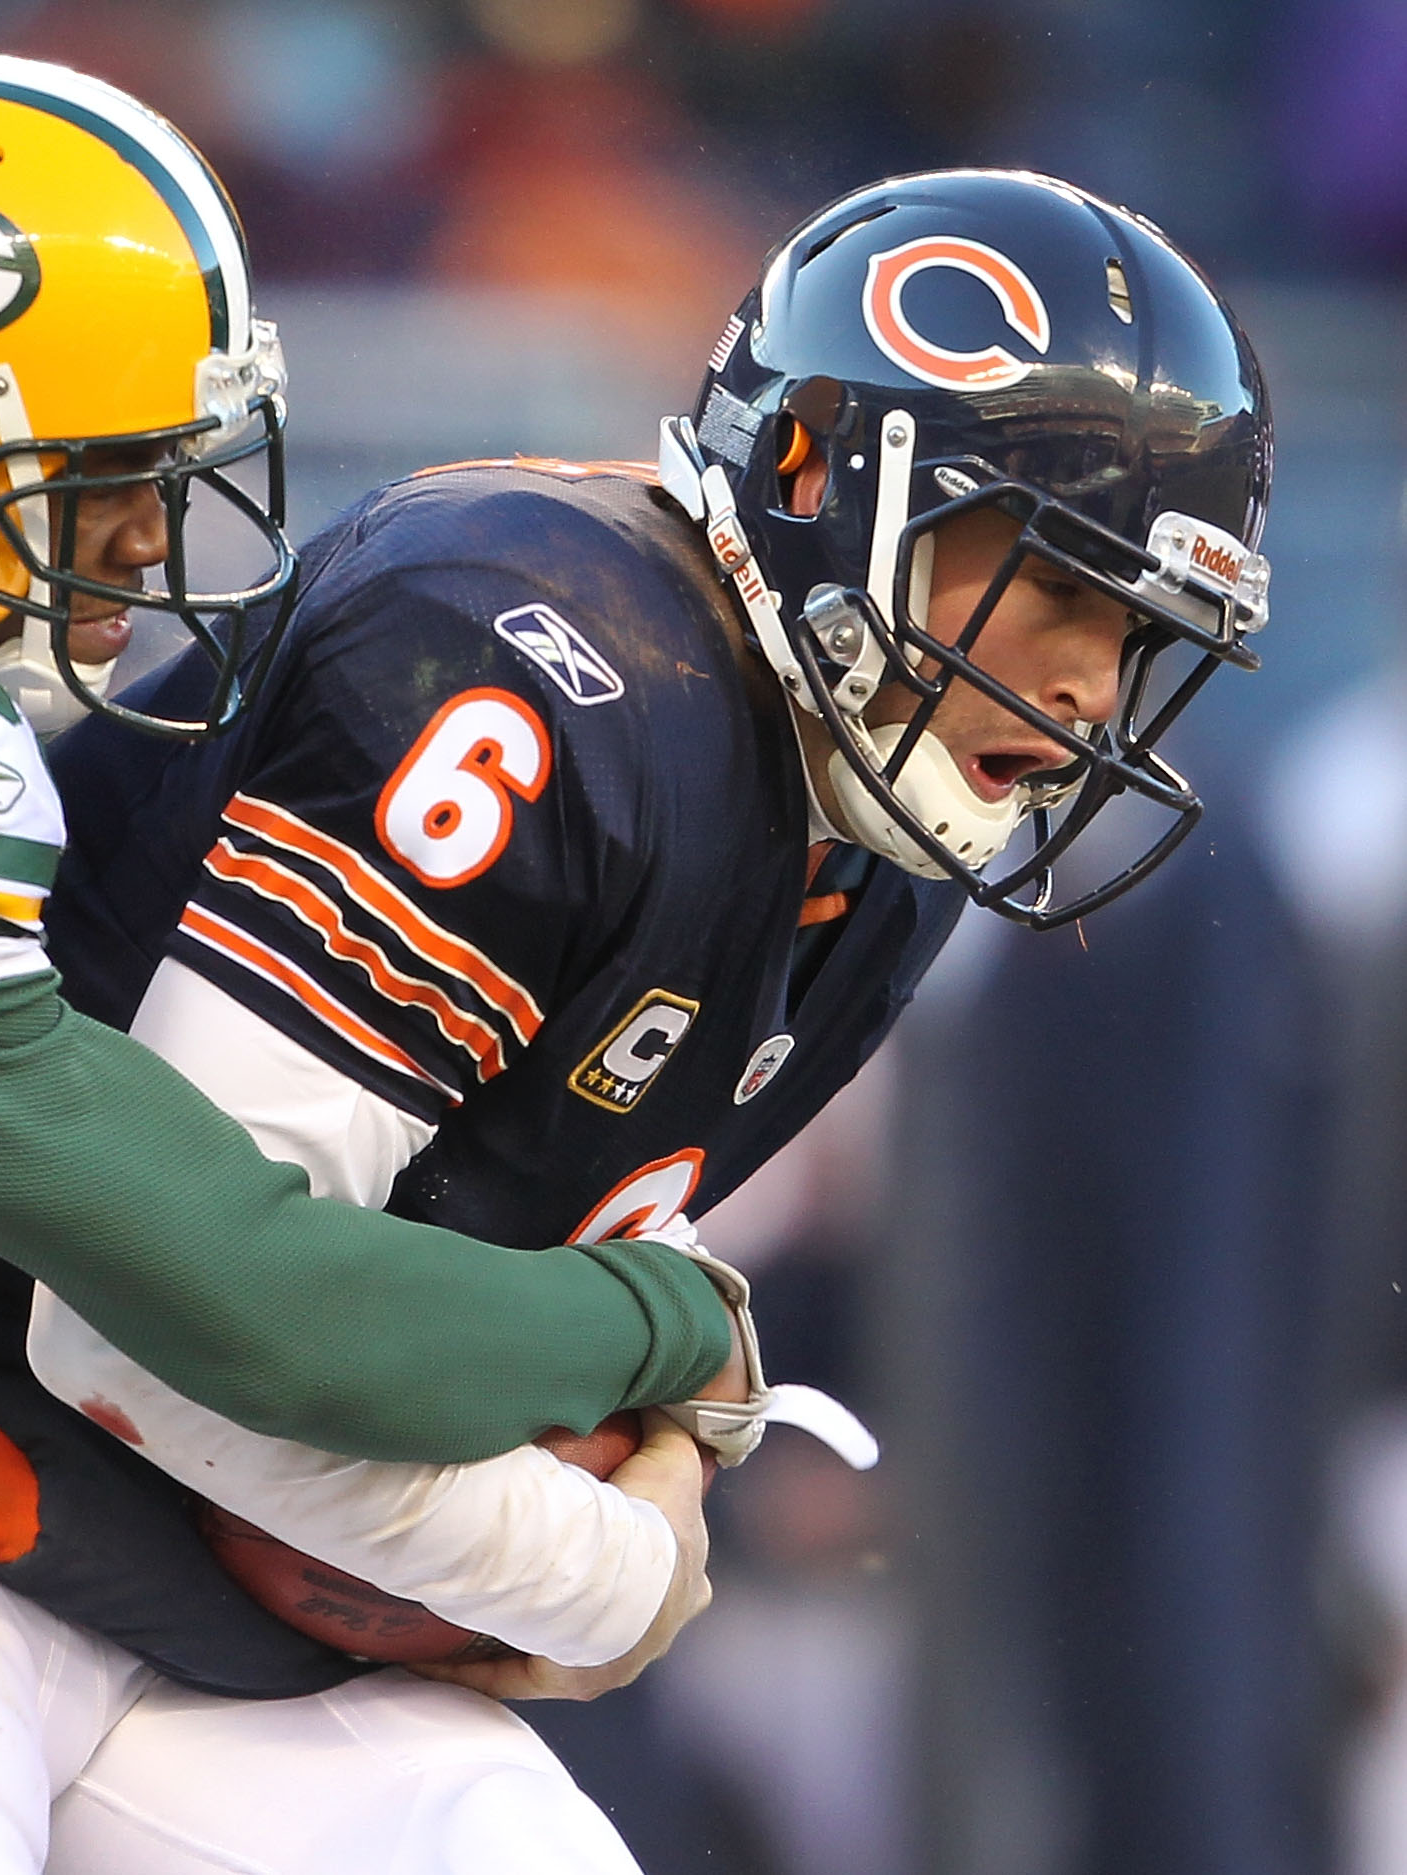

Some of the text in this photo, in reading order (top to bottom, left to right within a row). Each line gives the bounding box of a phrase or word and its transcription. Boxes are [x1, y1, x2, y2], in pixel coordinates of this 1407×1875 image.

[862, 235, 1050, 392] C
[374, 686, 553, 888] 6
[602, 1003, 691, 1082] C
